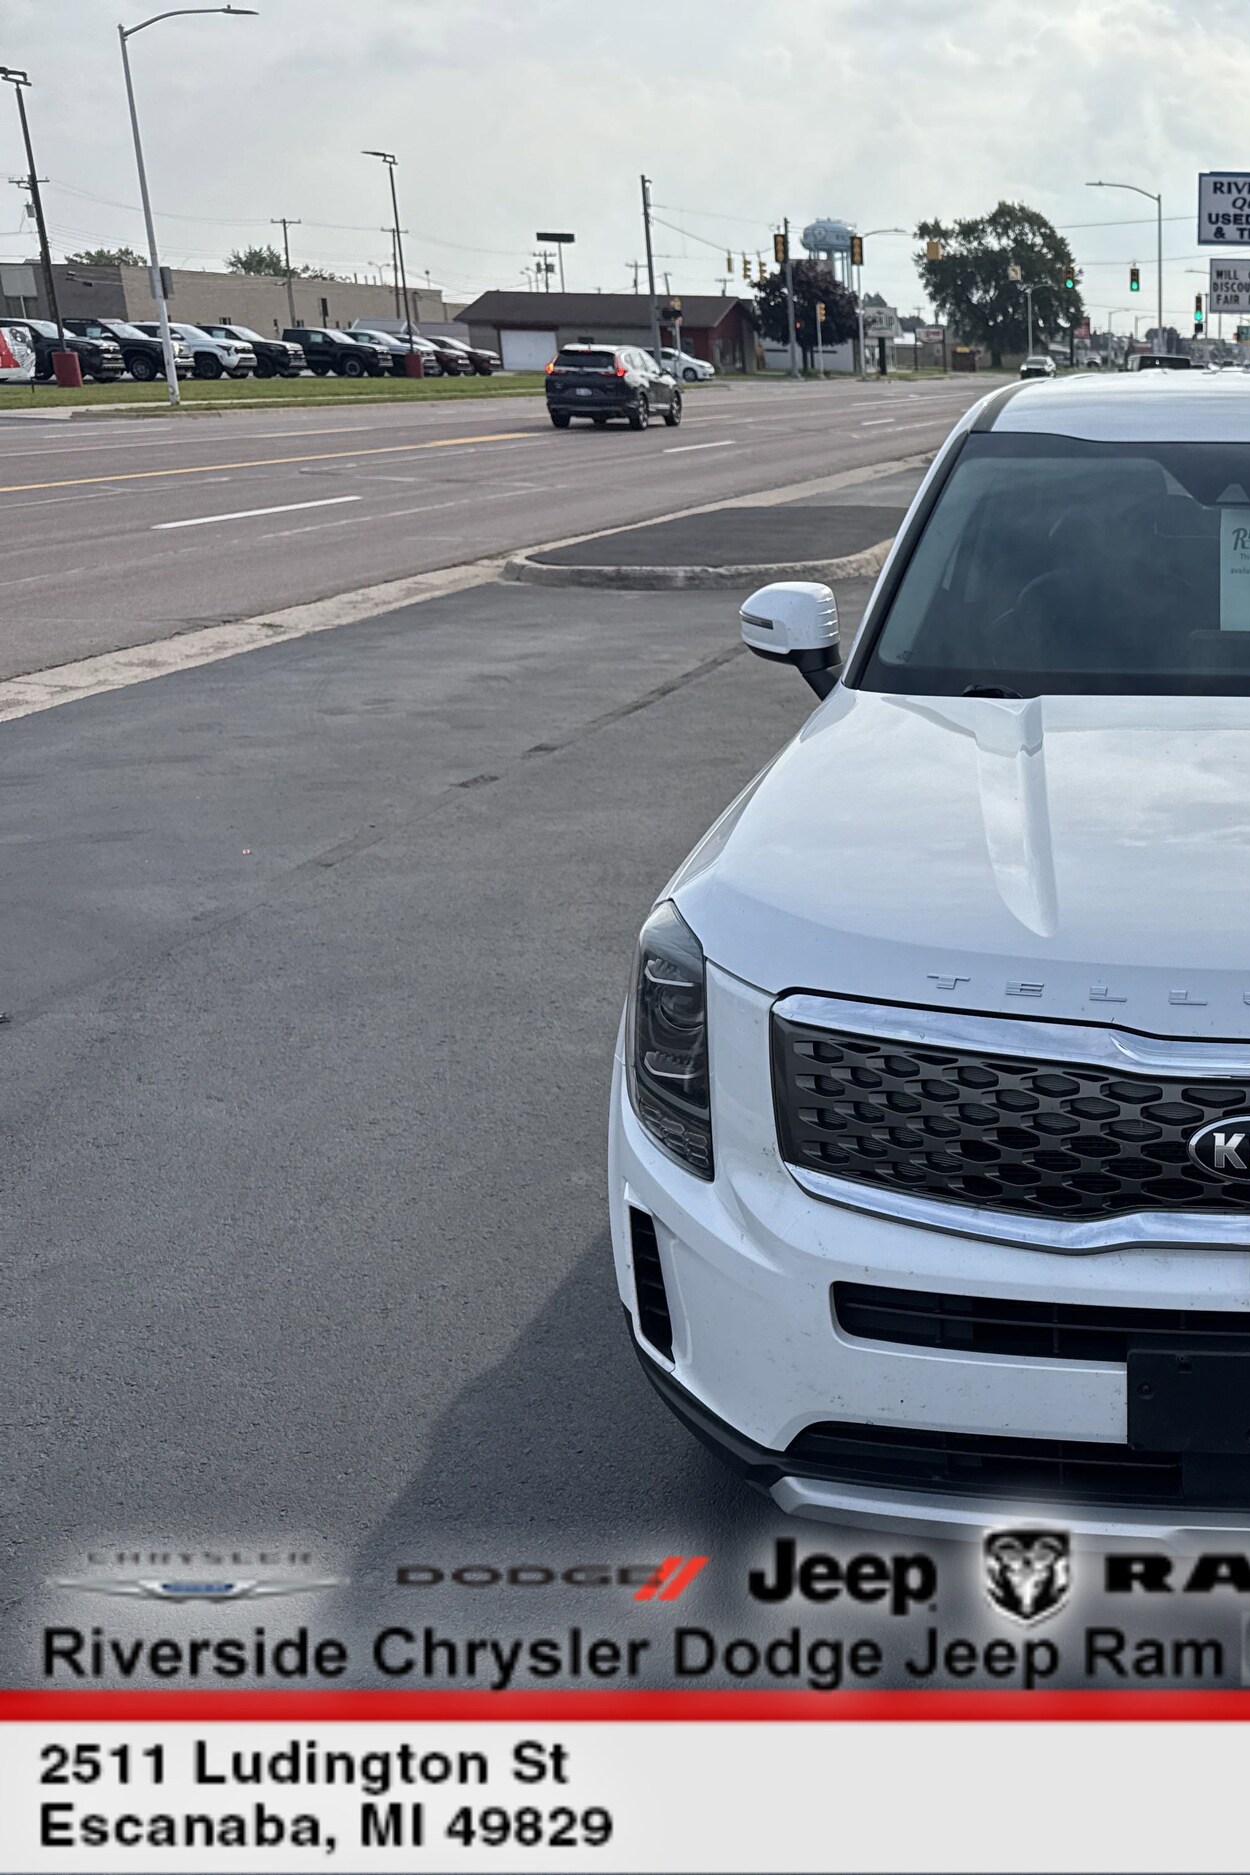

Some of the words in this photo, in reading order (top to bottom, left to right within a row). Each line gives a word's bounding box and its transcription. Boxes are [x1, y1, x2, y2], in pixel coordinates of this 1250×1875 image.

[1213, 227, 1226, 239] &
[1216, 270, 1239, 281] WILL
[1216, 295, 1239, 306] FAIR
